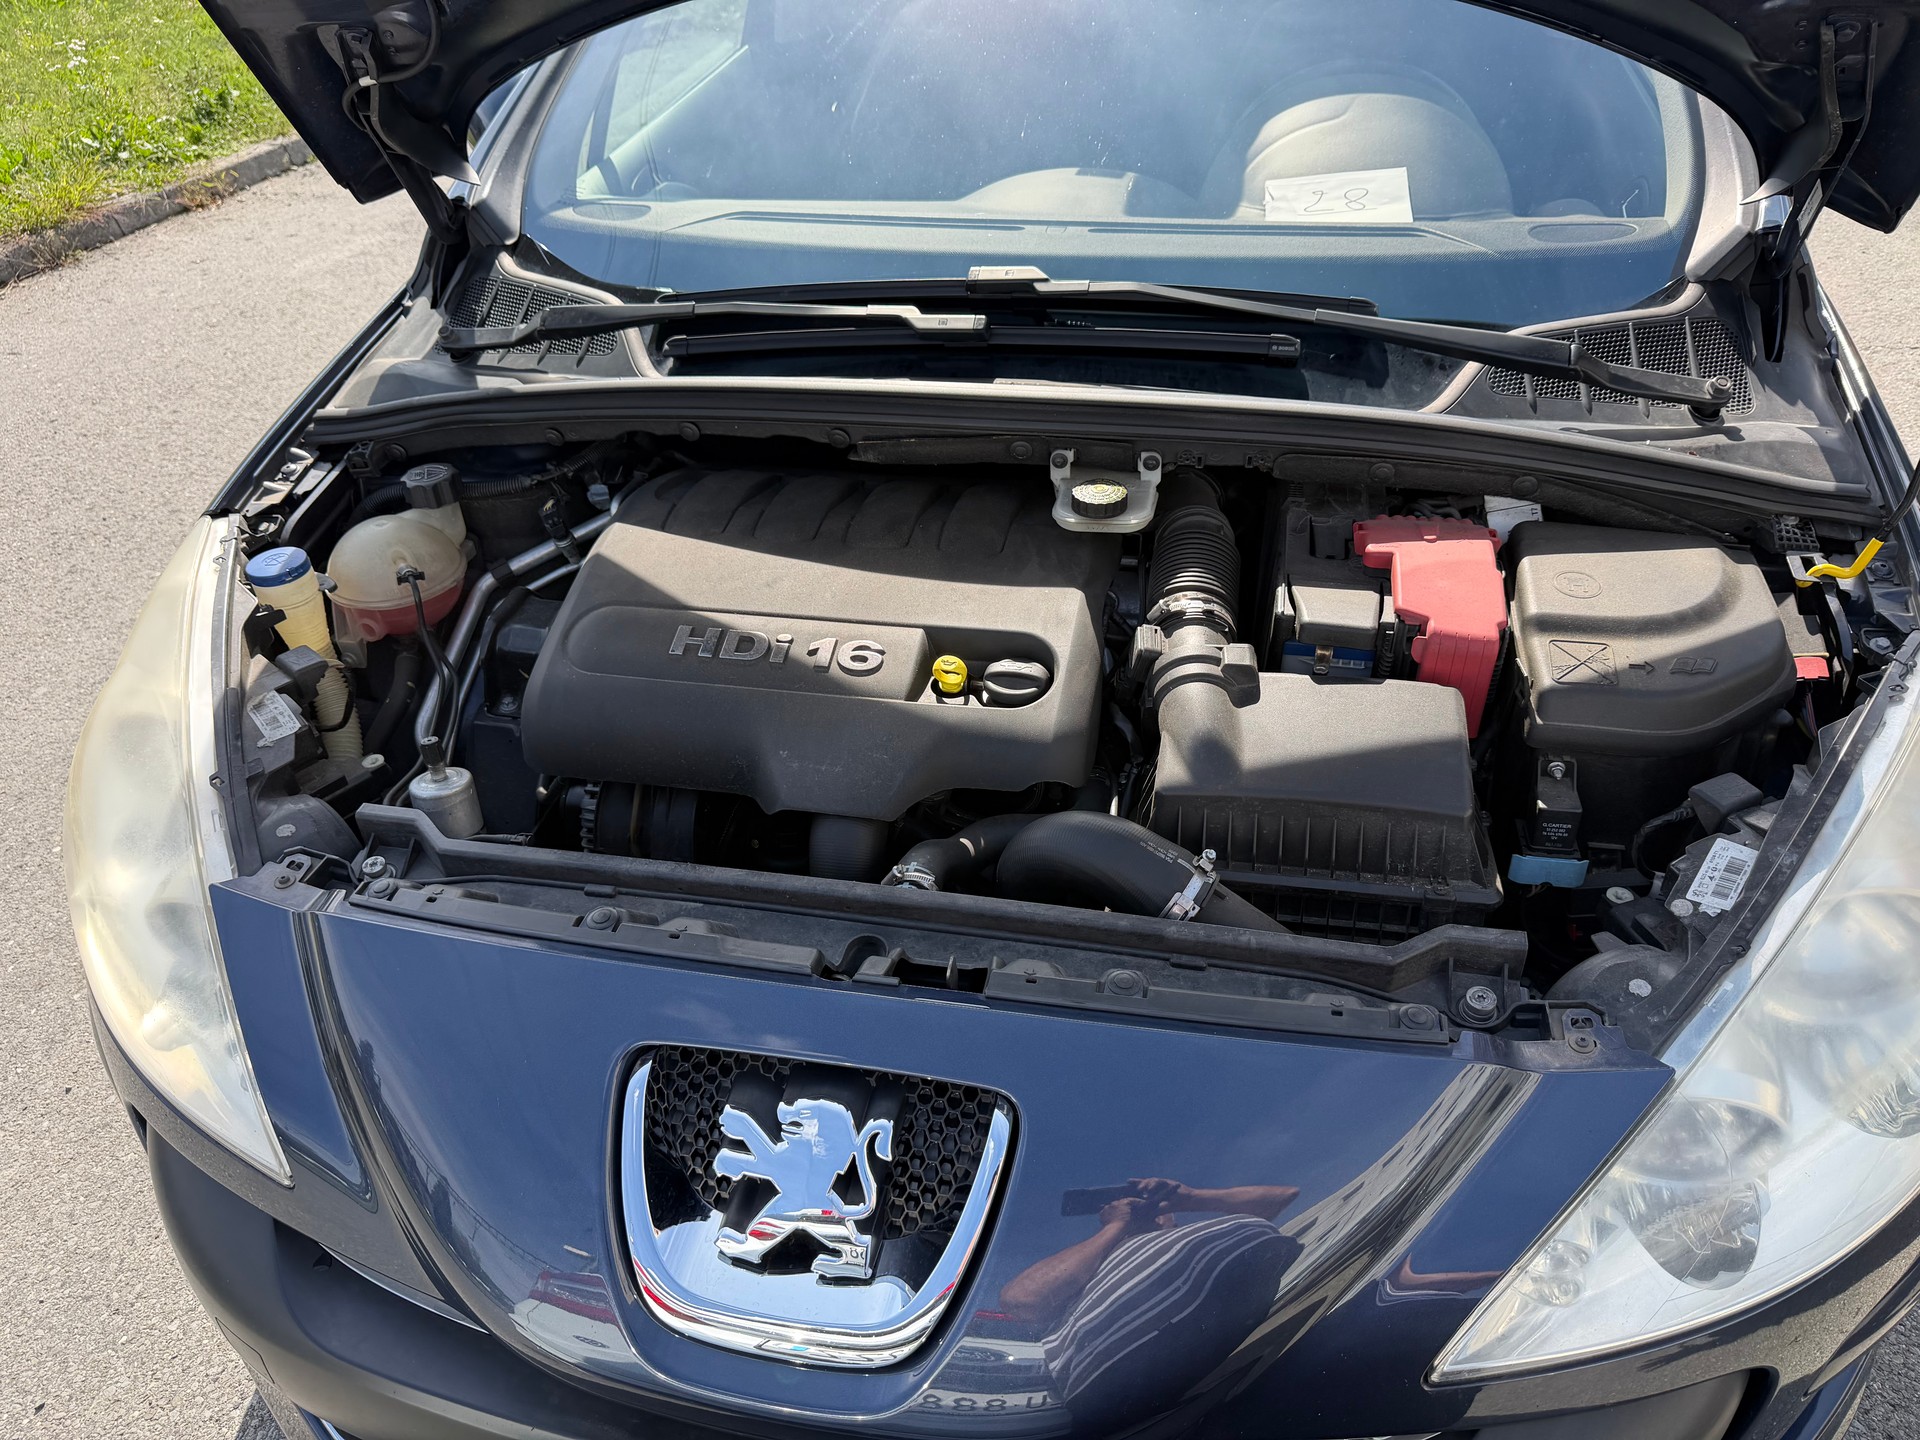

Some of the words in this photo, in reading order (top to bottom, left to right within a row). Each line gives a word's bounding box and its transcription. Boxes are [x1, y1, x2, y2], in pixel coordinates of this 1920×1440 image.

[1303, 187, 1369, 213] 28
[668, 624, 795, 664] HDi
[806, 637, 887, 678] 16
